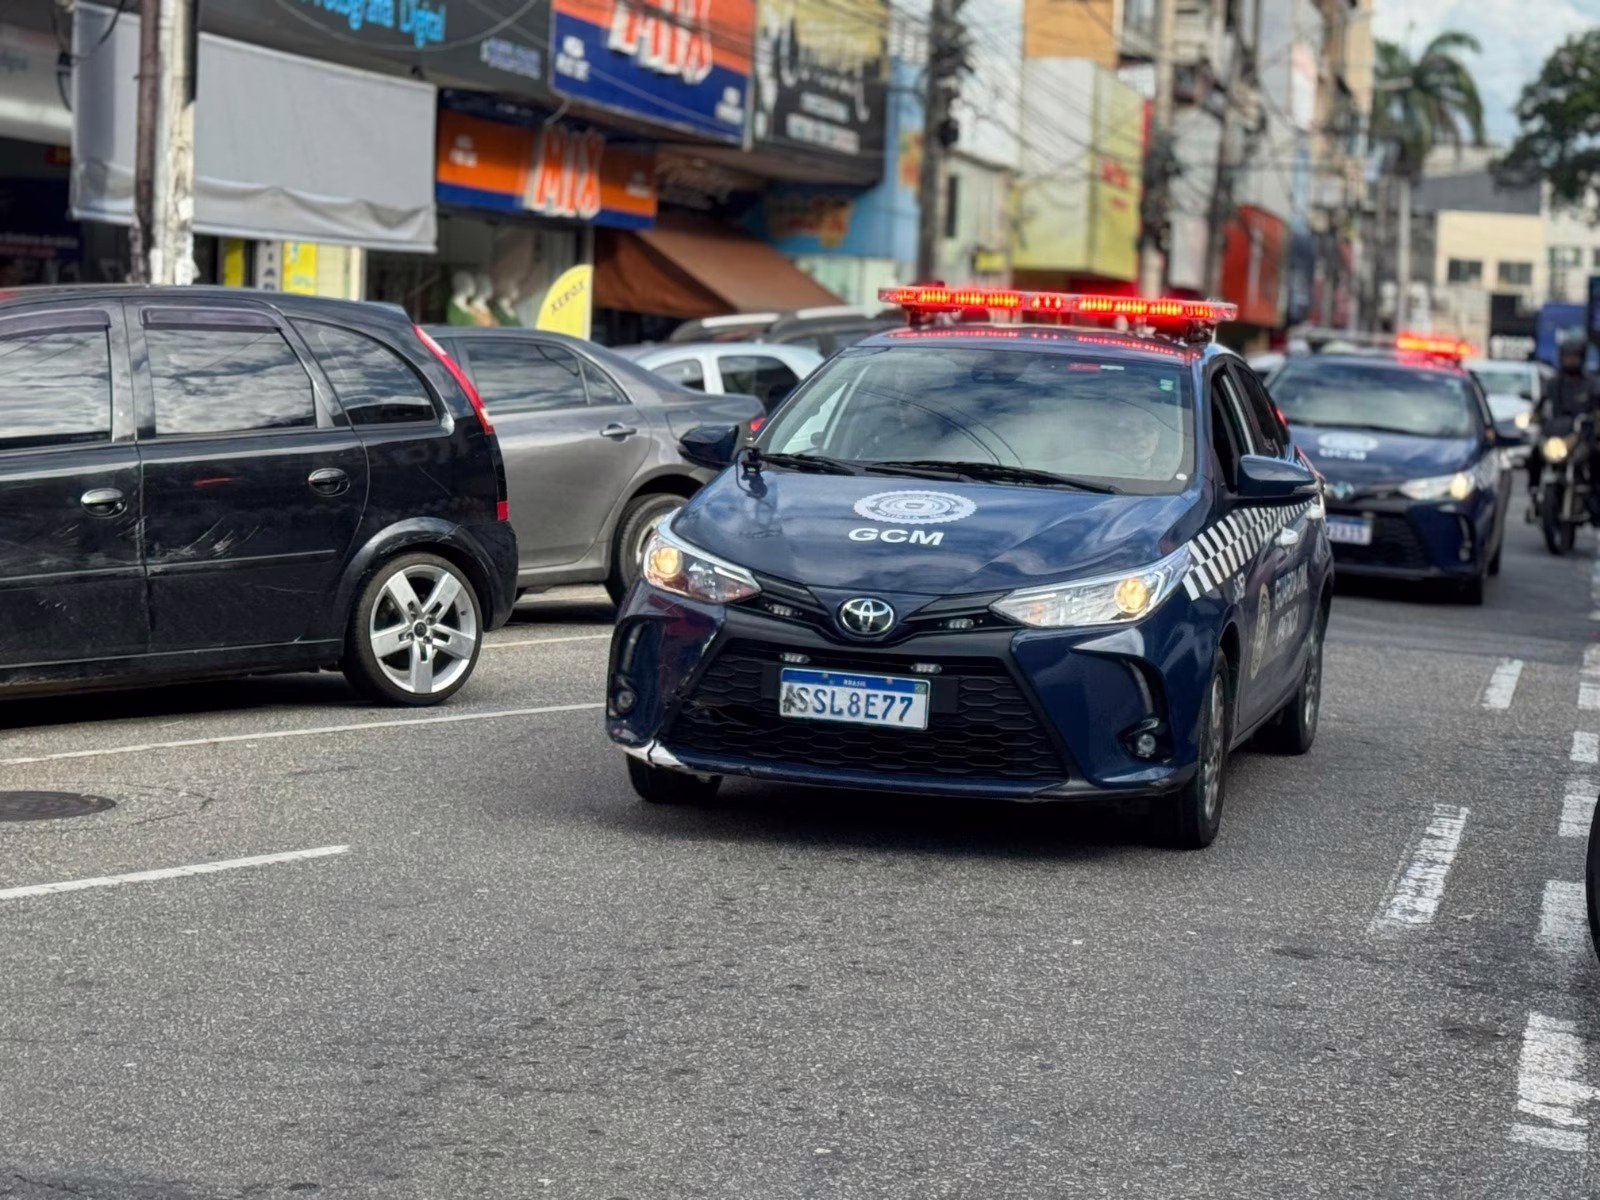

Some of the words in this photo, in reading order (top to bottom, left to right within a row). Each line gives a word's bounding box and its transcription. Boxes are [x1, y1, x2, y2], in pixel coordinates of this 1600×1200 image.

[526, 125, 604, 219] MIX
[848, 528, 945, 546] GCM
[795, 687, 914, 722] SSL8E77
